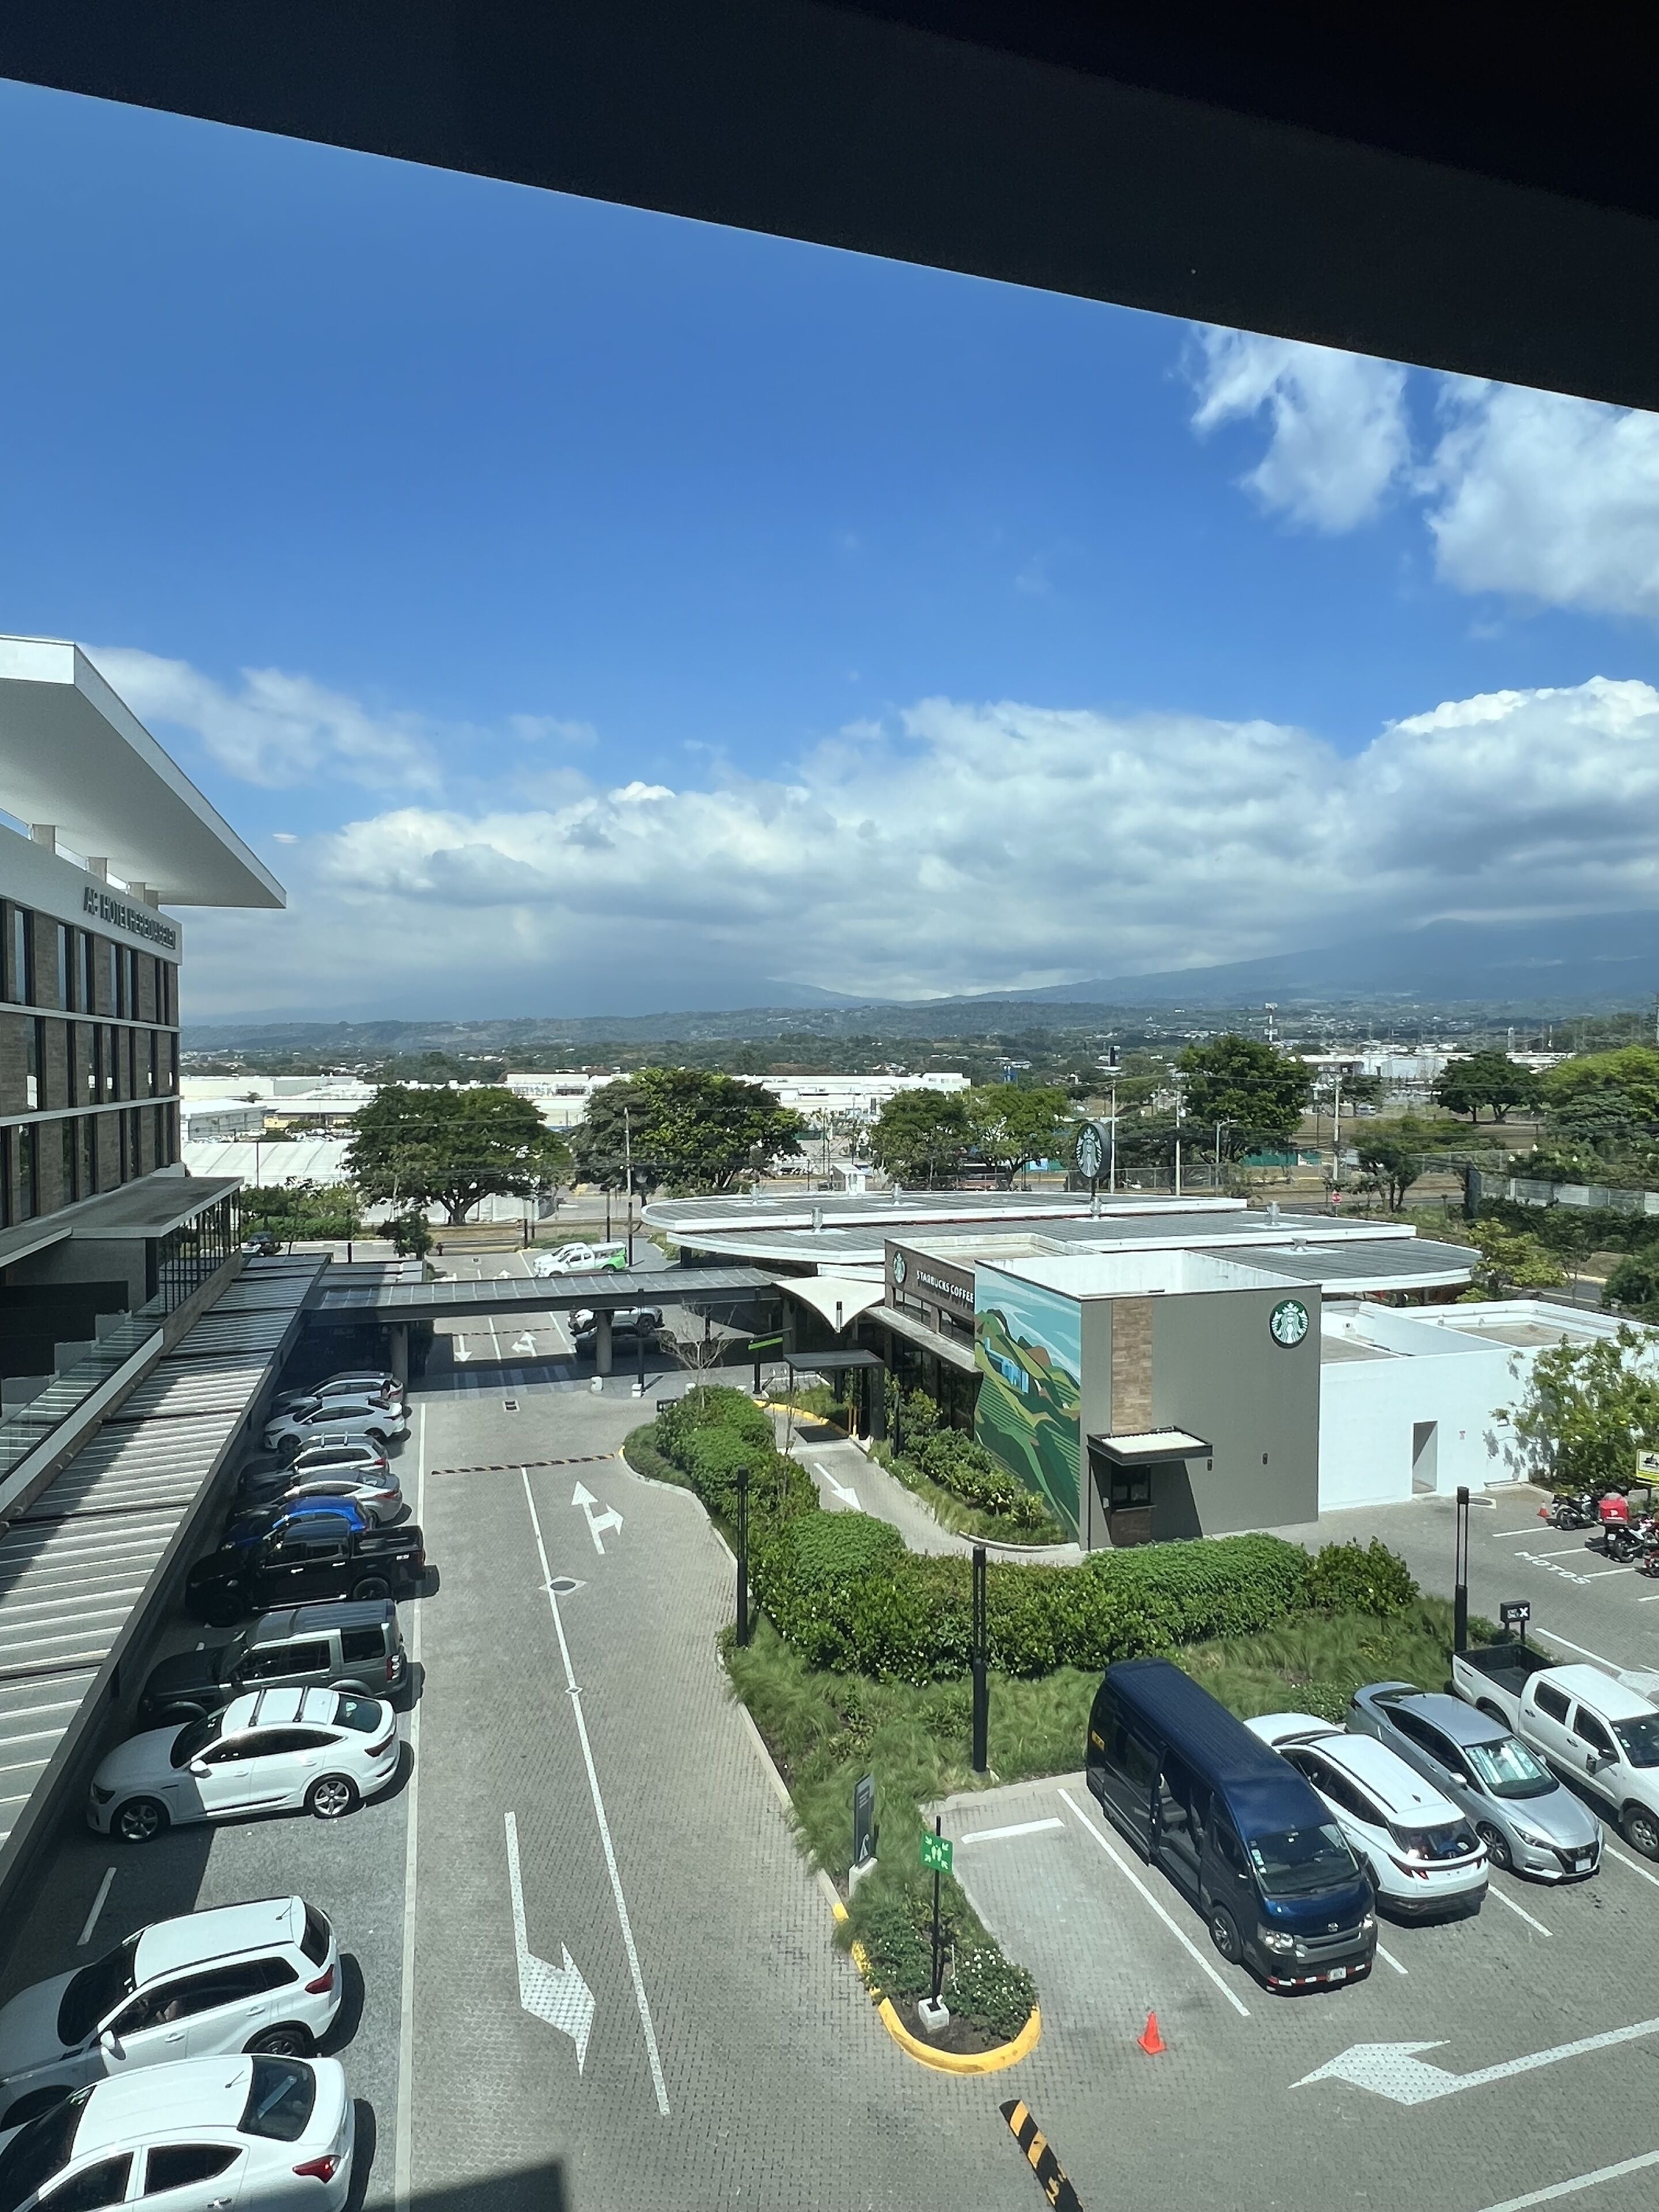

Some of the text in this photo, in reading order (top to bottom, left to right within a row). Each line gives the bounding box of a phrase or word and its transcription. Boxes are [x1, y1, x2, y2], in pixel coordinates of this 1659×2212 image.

[916, 1270, 974, 1304] STARBUCKS COFFEE
[1514, 1551, 1592, 1584] MOTOS
